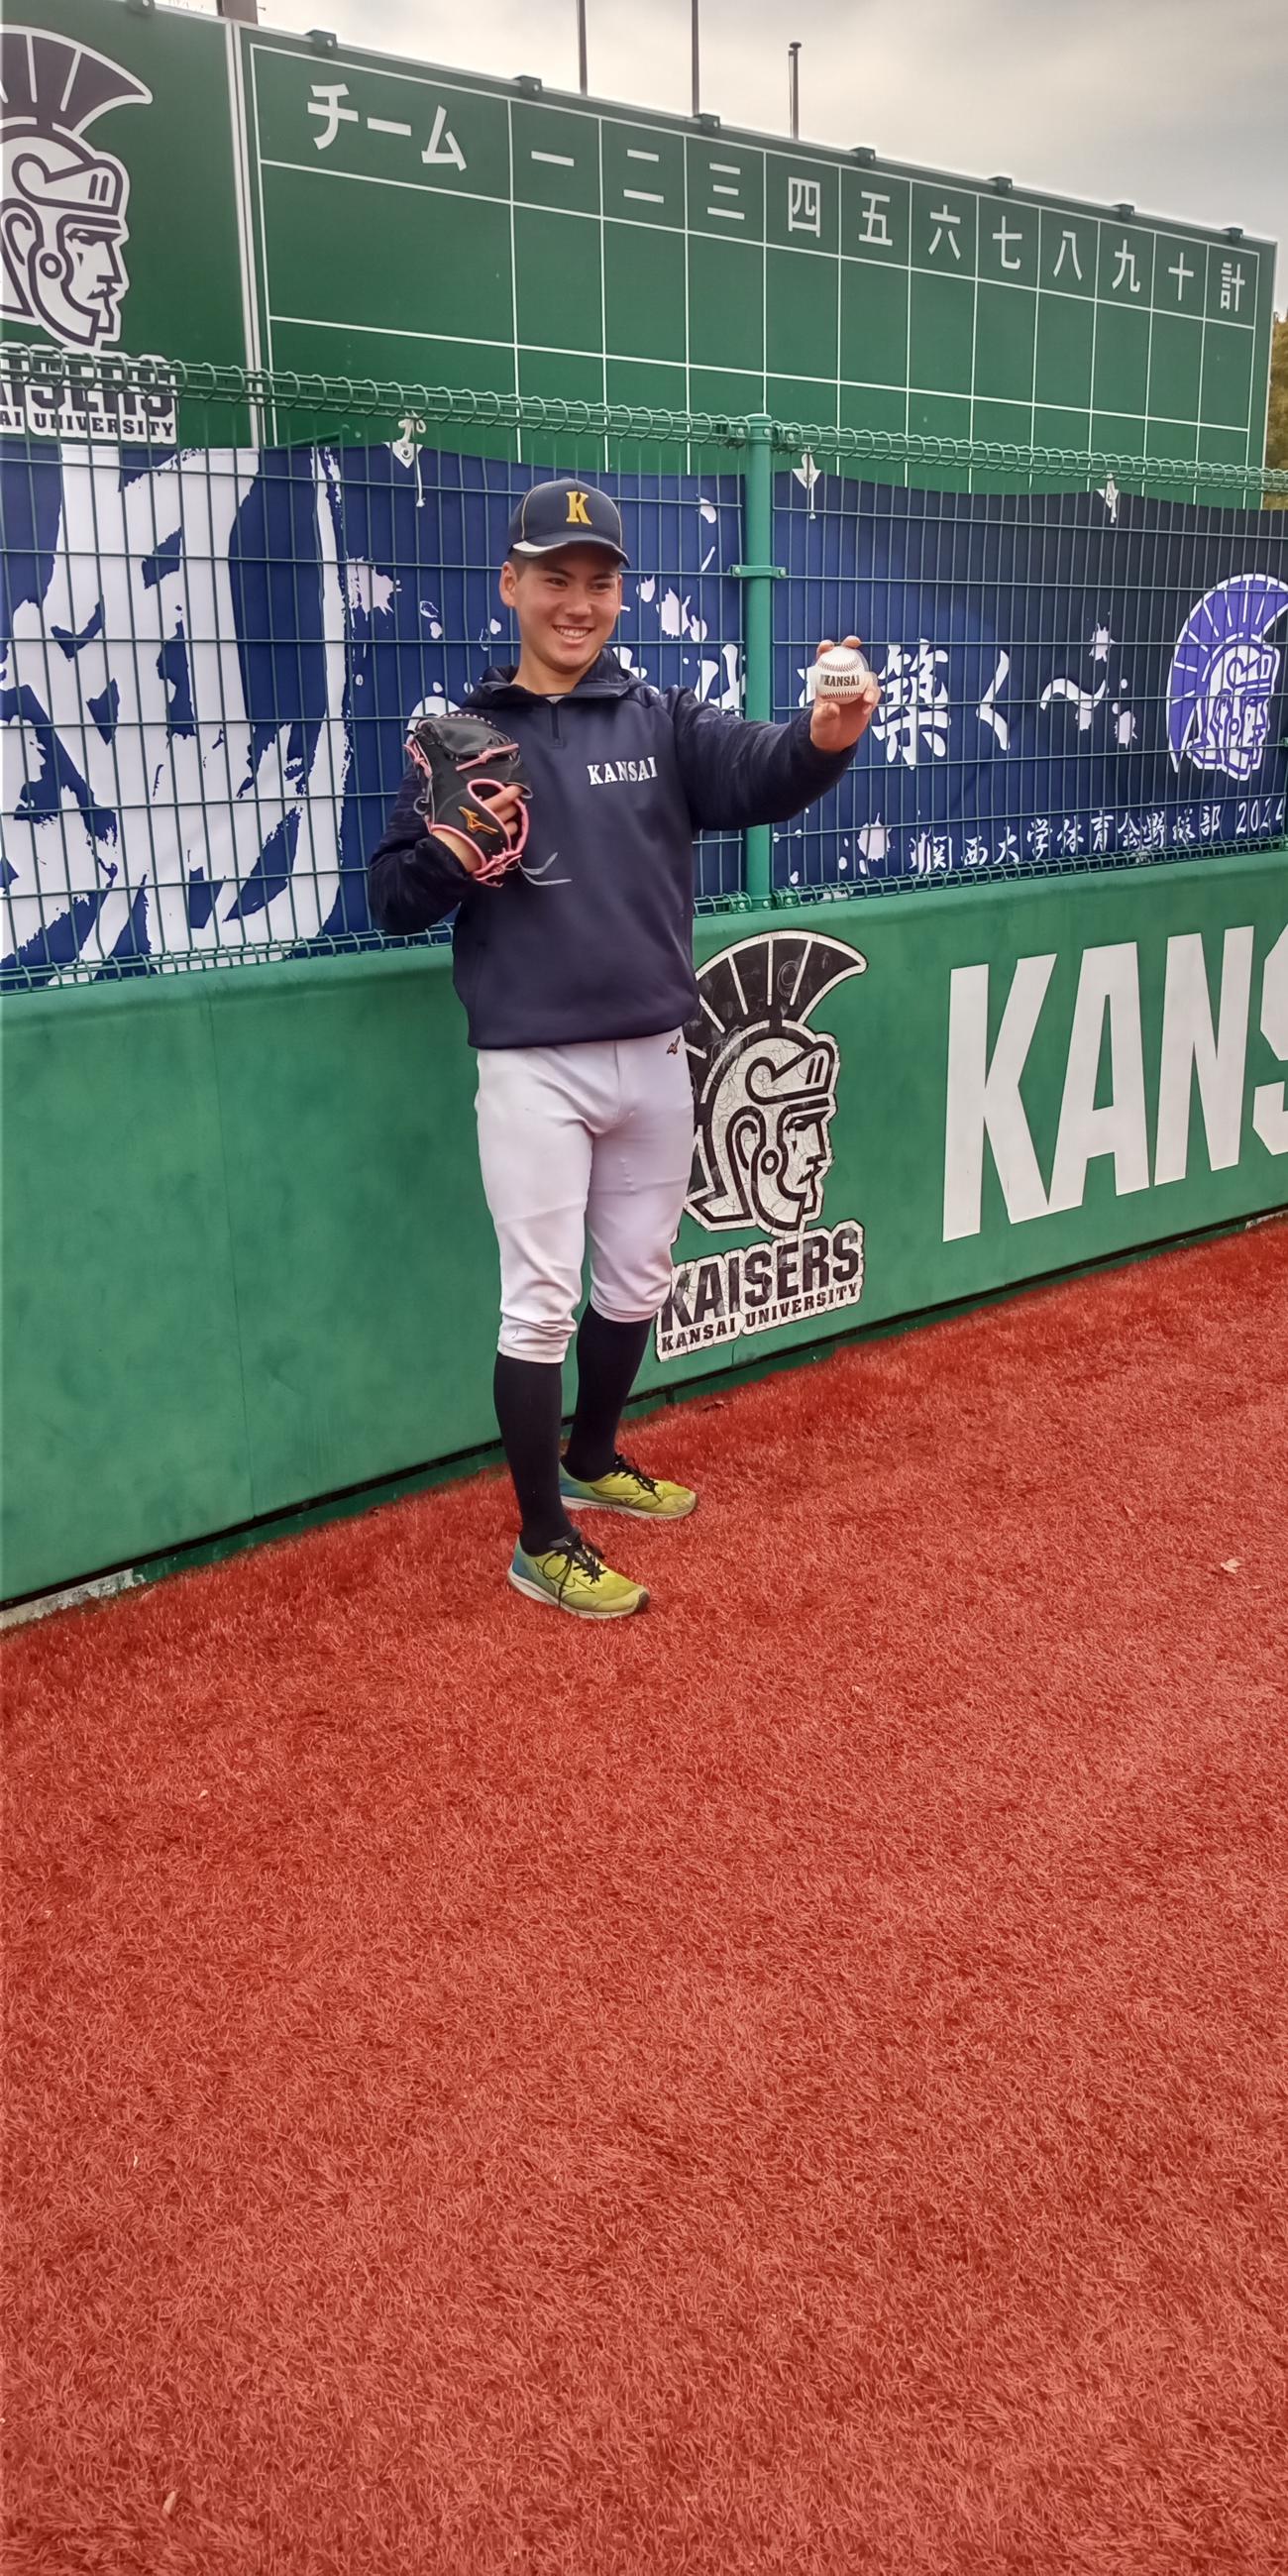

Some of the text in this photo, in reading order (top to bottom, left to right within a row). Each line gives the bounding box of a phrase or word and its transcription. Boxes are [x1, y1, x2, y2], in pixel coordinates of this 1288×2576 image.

[307, 83, 467, 170] チーム
[623, 149, 665, 204] 二
[706, 162, 745, 220] 三
[788, 176, 820, 238] 四
[858, 190, 893, 246] 五
[927, 204, 961, 260] 六
[992, 216, 1022, 270] 七
[1053, 230, 1083, 280] 八
[1112, 239, 1140, 292] 九
[1168, 252, 1194, 301] 十
[1221, 262, 1245, 312] 計
[34, 412, 173, 437] UNIVERSITY
[566, 491, 591, 525] K
[824, 674, 860, 687] KANSAI
[588, 757, 658, 786] KANSAI
[661, 1227, 859, 1334] KAISERS
[661, 1282, 858, 1352] KANSAI UNIVERSITY
